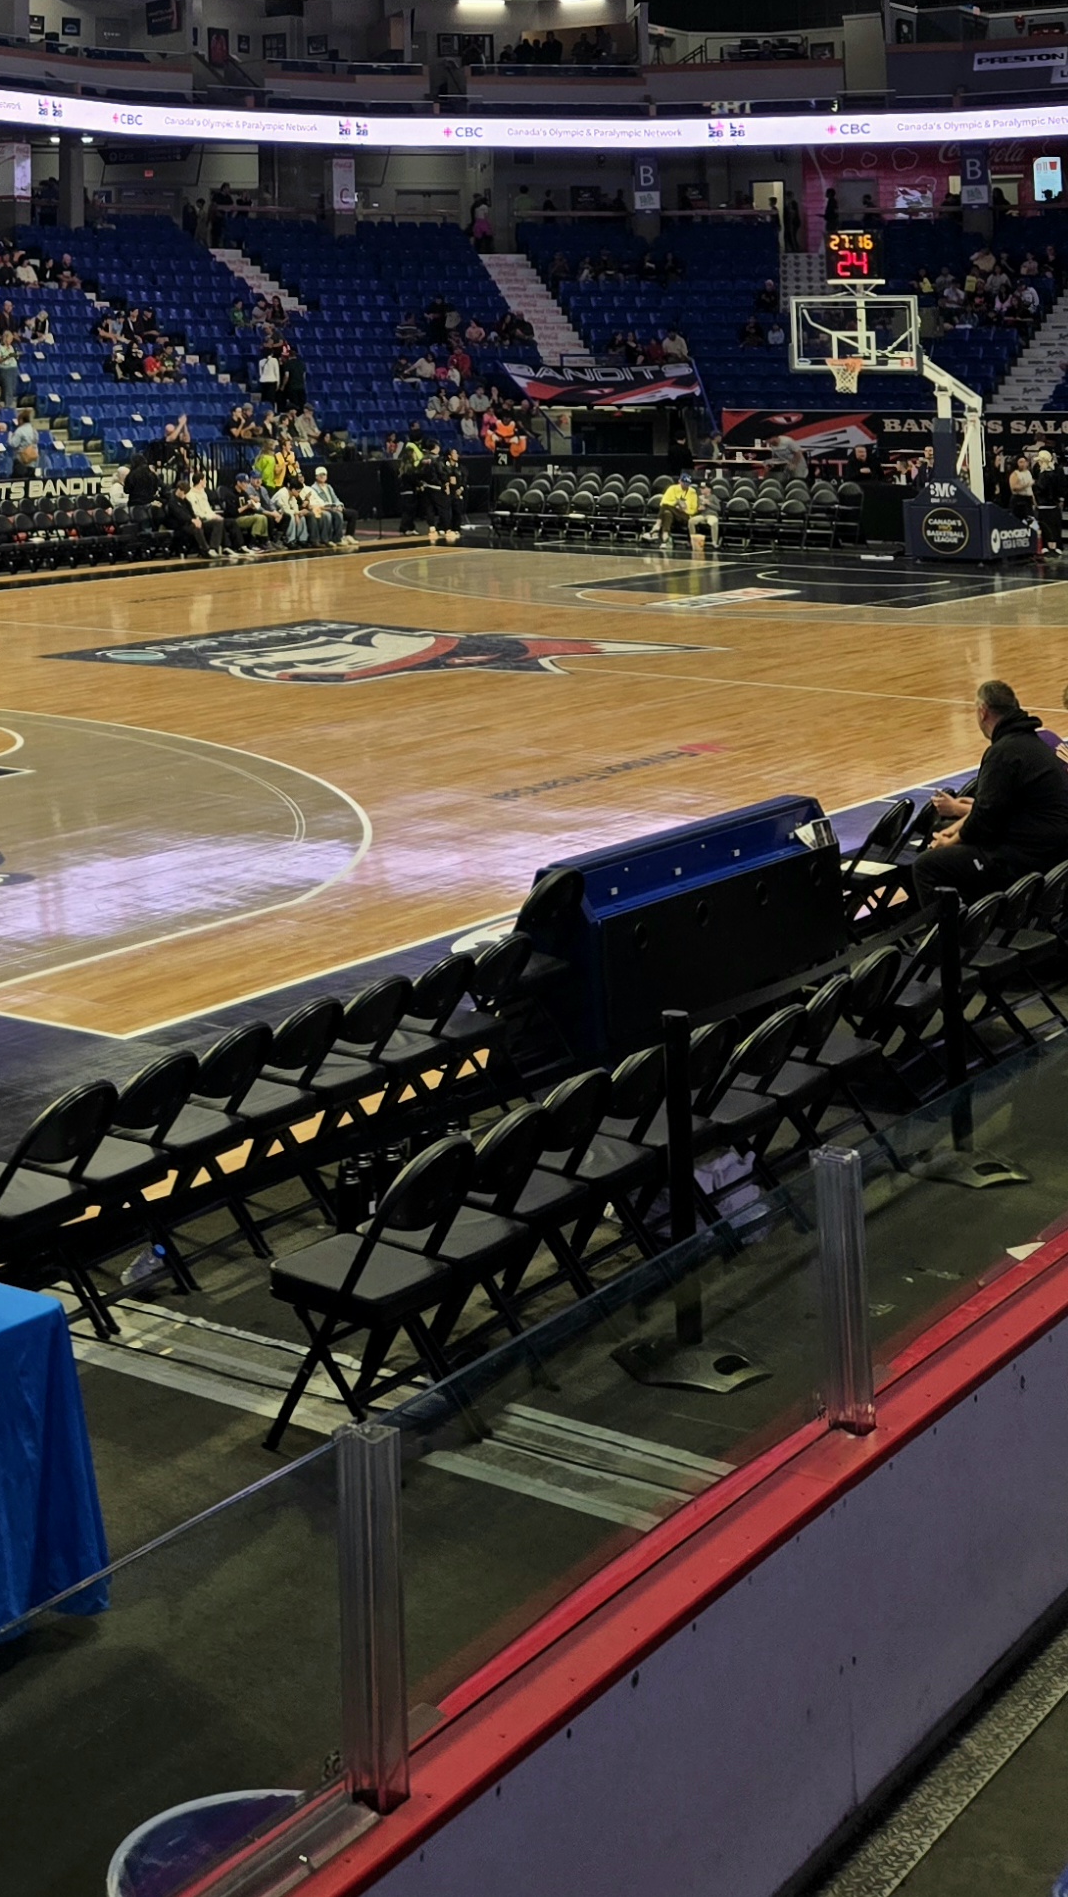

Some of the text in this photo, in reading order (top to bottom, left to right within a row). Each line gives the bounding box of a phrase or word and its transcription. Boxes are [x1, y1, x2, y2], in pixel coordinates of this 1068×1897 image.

[977, 53, 1065, 65] PRESTON
[120, 113, 143, 126] CBC
[165, 116, 201, 126] Canada's
[839, 123, 871, 135] CBC
[897, 121, 941, 131] Canada's
[943, 120, 982, 130] Olympic
[984, 120, 990, 128] &
[993, 117, 1045, 129] Paralympic
[455, 127, 483, 137] CBC
[507, 127, 547, 137] Canada's
[549, 128, 583, 139] Olympic
[594, 128, 641, 139] Paralympic
[643, 128, 682, 137] Network
[639, 165, 654, 186] B
[966, 158, 982, 180] B
[829, 234, 873, 250] 27:16
[837, 250, 869, 276] 24
[28, 477, 113, 497] BANDITS
[928, 518, 962, 526] CANADA'S
[926, 530, 965, 539] BASKETBALL
[1000, 528, 1032, 540] OXYGEN
